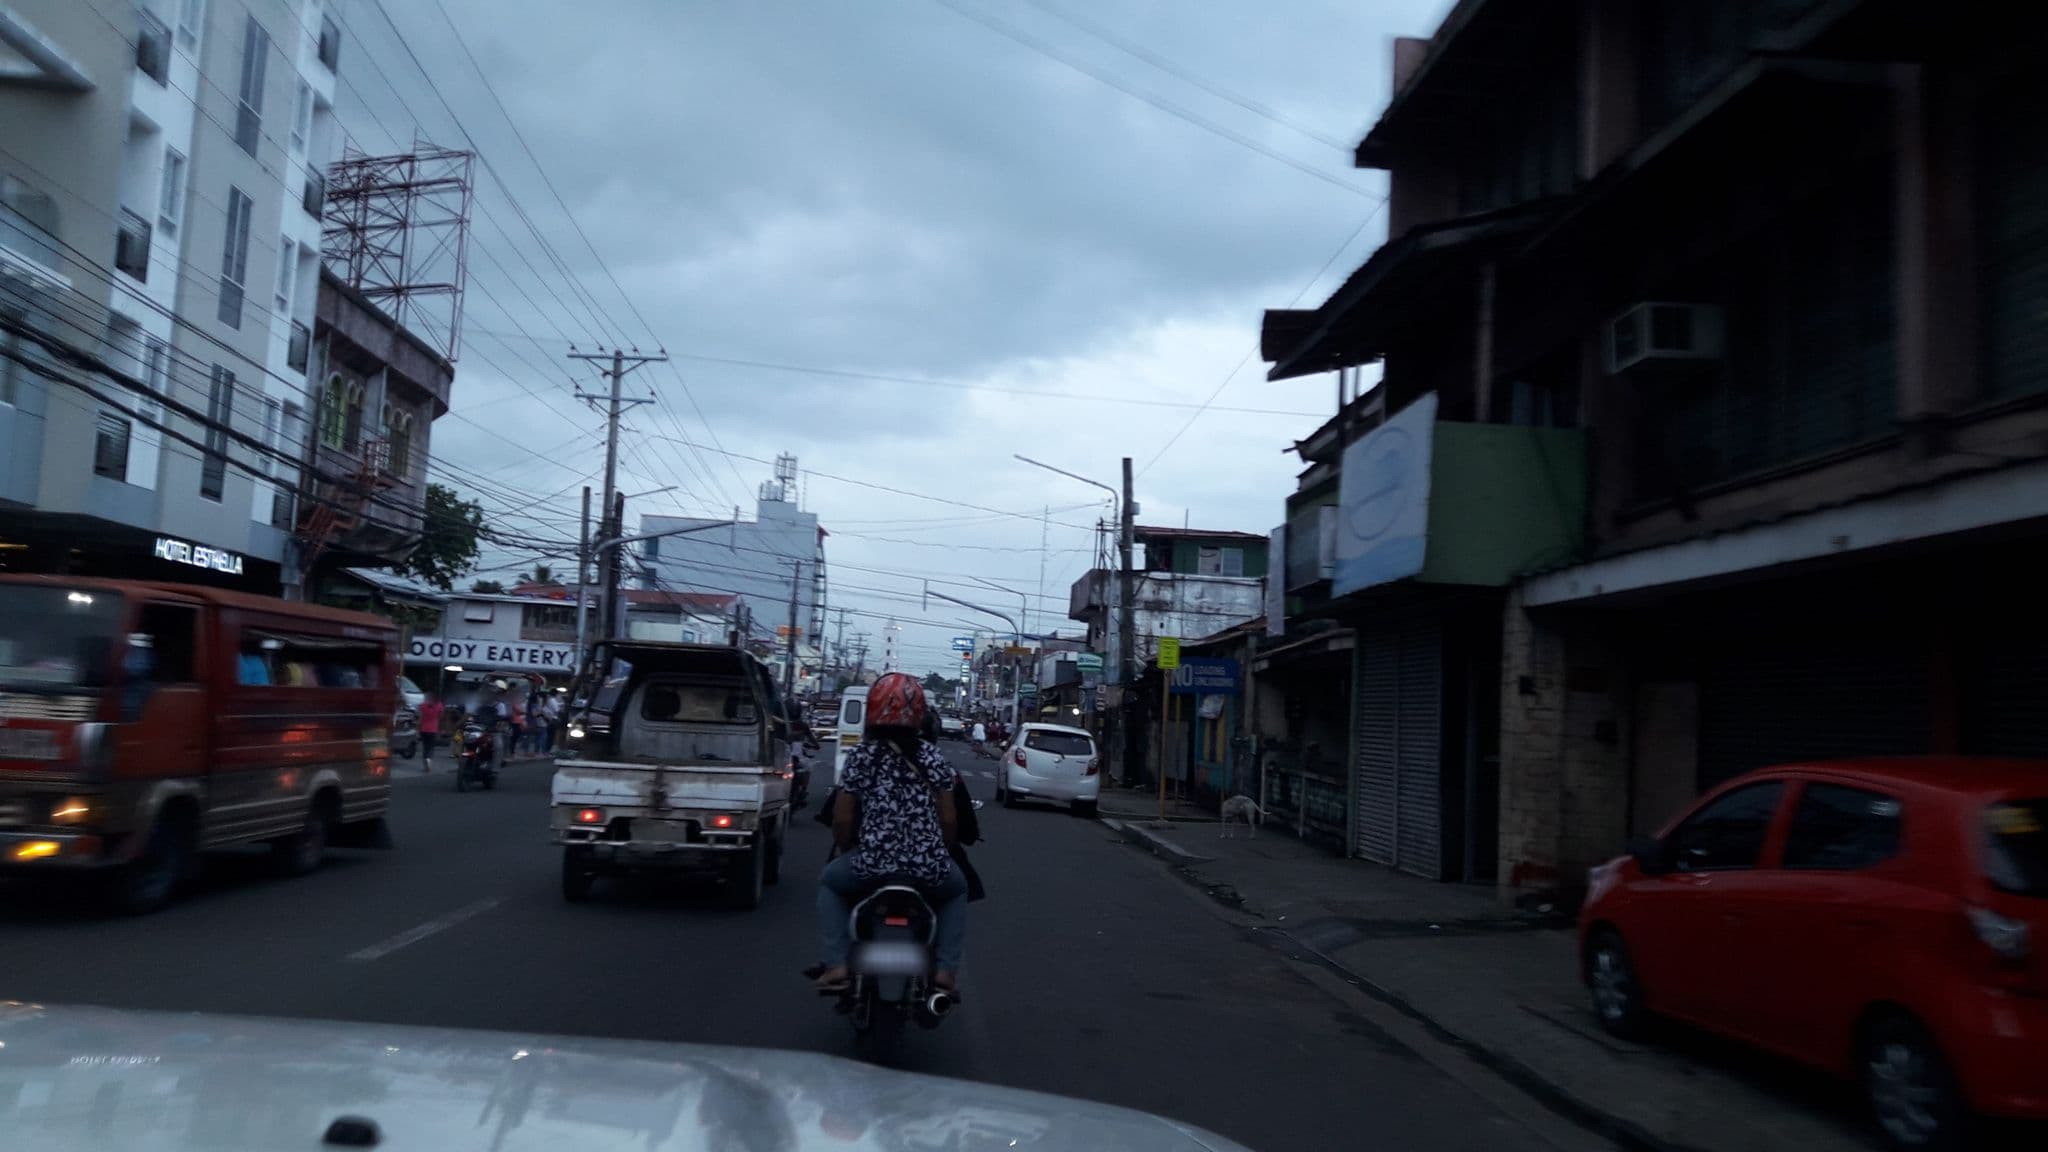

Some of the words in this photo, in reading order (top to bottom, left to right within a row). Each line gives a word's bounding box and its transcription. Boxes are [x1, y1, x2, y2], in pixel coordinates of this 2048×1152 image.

[155, 537, 193, 564] HOTEL
[193, 546, 243, 575] ESTRELLA
[487, 646, 568, 665] EATERY
[1171, 663, 1193, 687] NO
